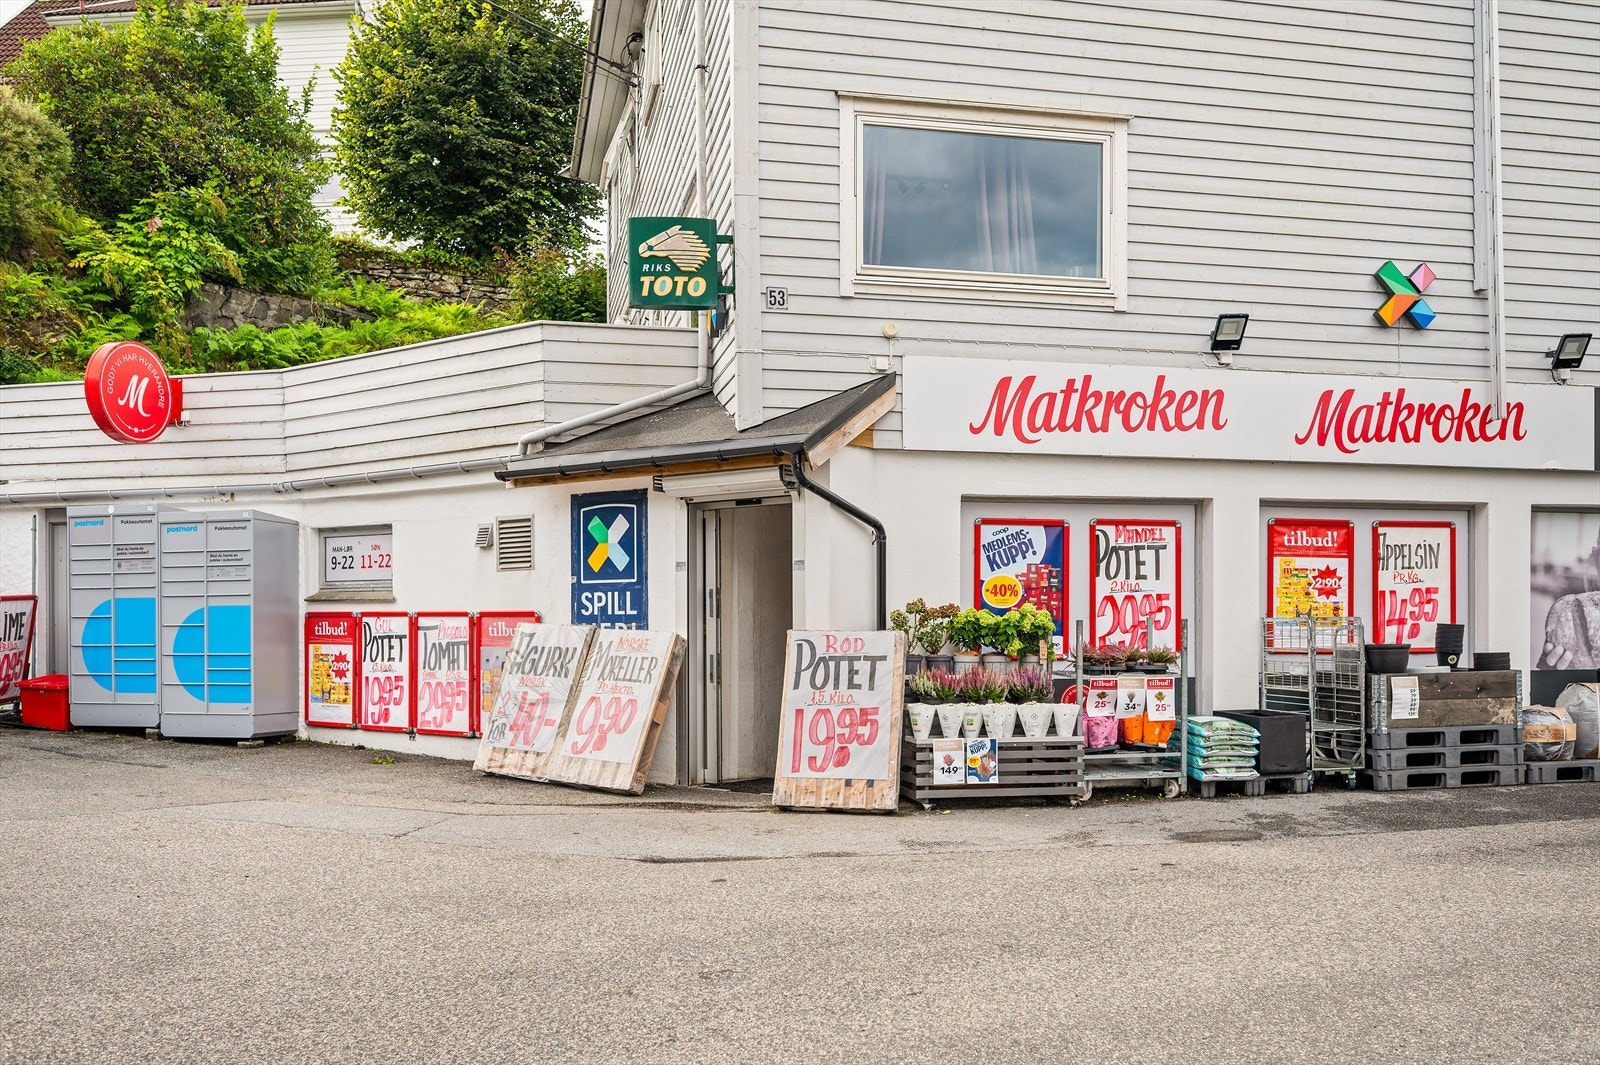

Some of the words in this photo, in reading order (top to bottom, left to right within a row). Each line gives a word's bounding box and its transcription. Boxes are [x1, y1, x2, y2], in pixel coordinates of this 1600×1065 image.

[642, 264, 671, 272] RIKS
[640, 276, 707, 297] TOTO
[769, 290, 785, 306] 53
[107, 366, 117, 394] GODT
[114, 359, 123, 367] VI
[122, 353, 138, 363] HAR
[118, 374, 152, 418] M
[969, 374, 1228, 445] Matkroken
[1294, 388, 1527, 454] Matkroken
[74, 519, 104, 528] postnord
[166, 525, 198, 534] postnord
[992, 526, 1009, 537] coop
[982, 529, 1030, 554] MEDLEMS-
[1115, 525, 1167, 543] MANDEL
[1283, 530, 1338, 547] tilbud!
[986, 538, 1037, 572] KUPP!
[1096, 528, 1167, 580] POTET
[1378, 532, 1440, 571] APPELSIN
[331, 556, 354, 570] 9-22
[360, 554, 392, 568] 11-22
[985, 584, 1018, 597] -40%
[580, 591, 638, 616] SPILL
[314, 621, 348, 636] tilbud!
[374, 616, 394, 632] GUL
[488, 621, 515, 637] tilbu
[362, 622, 408, 662] POTET
[617, 635, 650, 652] NORSKE
[821, 634, 866, 656] RØD
[792, 638, 888, 692] POTET
[940, 766, 958, 774] 149
